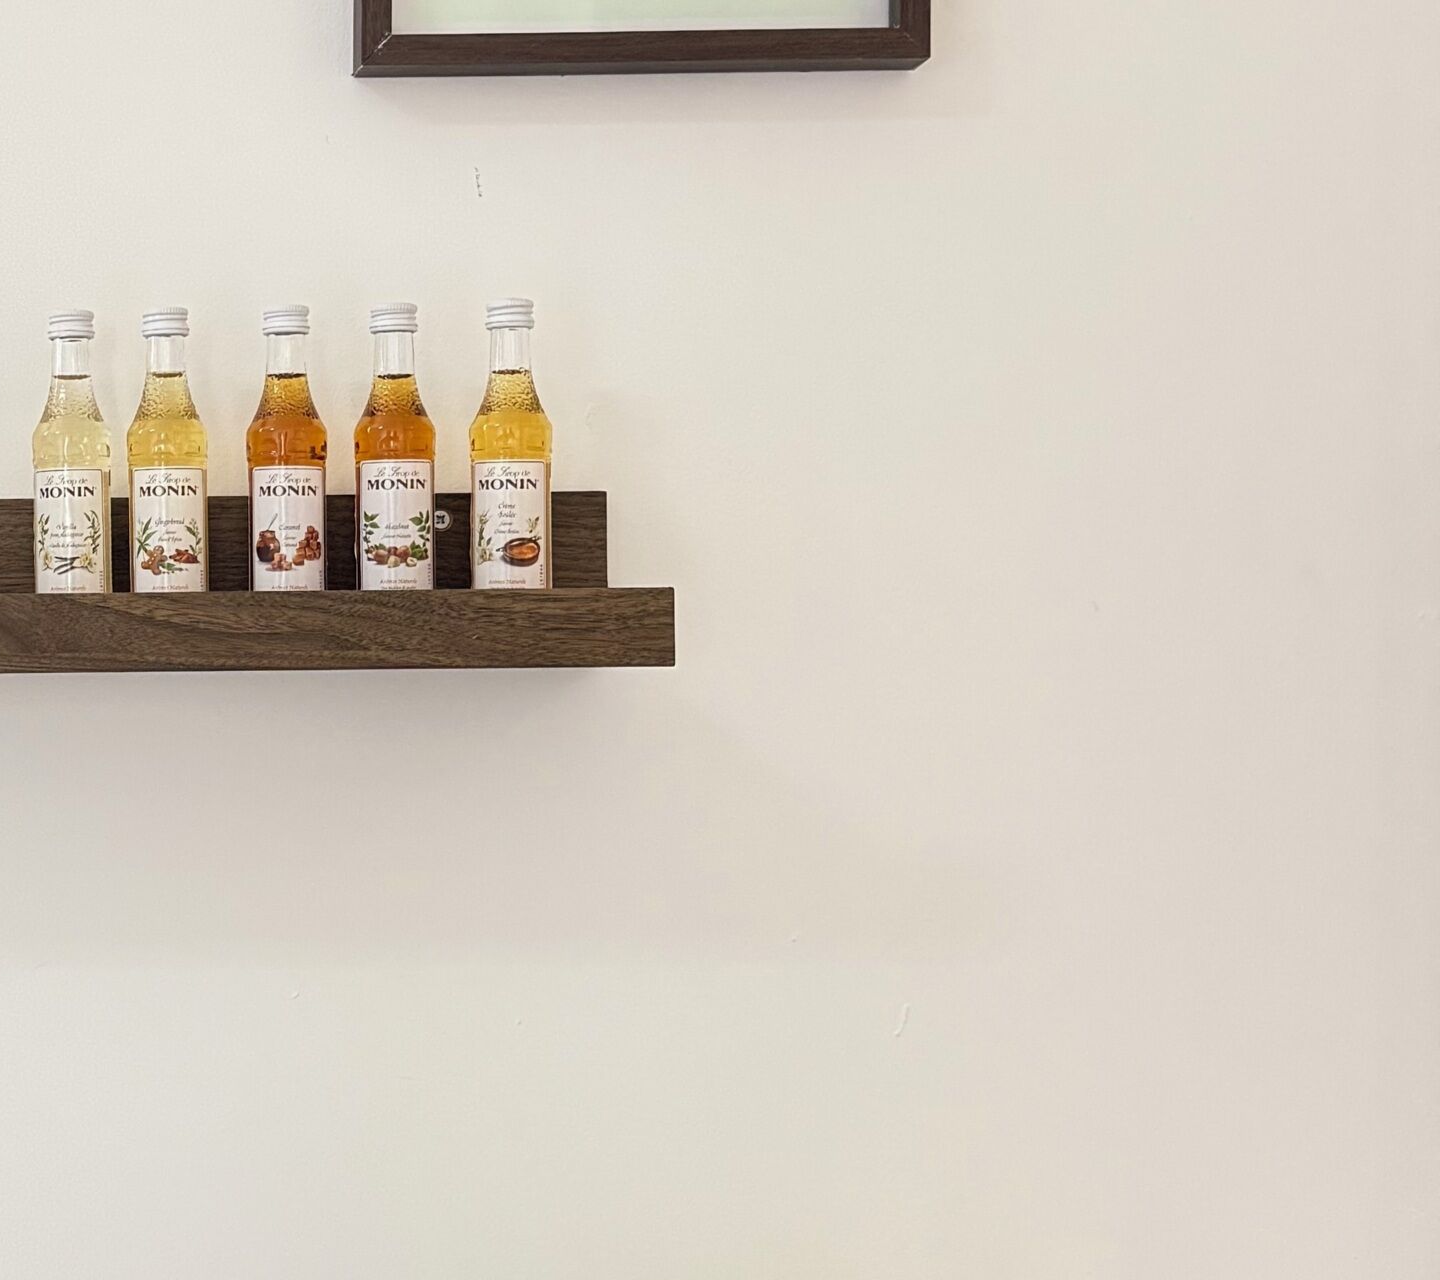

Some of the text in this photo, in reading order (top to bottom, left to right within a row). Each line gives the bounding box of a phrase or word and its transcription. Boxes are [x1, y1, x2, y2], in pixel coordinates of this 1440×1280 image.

[259, 484, 317, 497] MONIN
[367, 478, 426, 491] MONIN
[478, 478, 538, 491] MONIN
[39, 486, 96, 499] MONIN
[139, 485, 197, 498] MONIN
